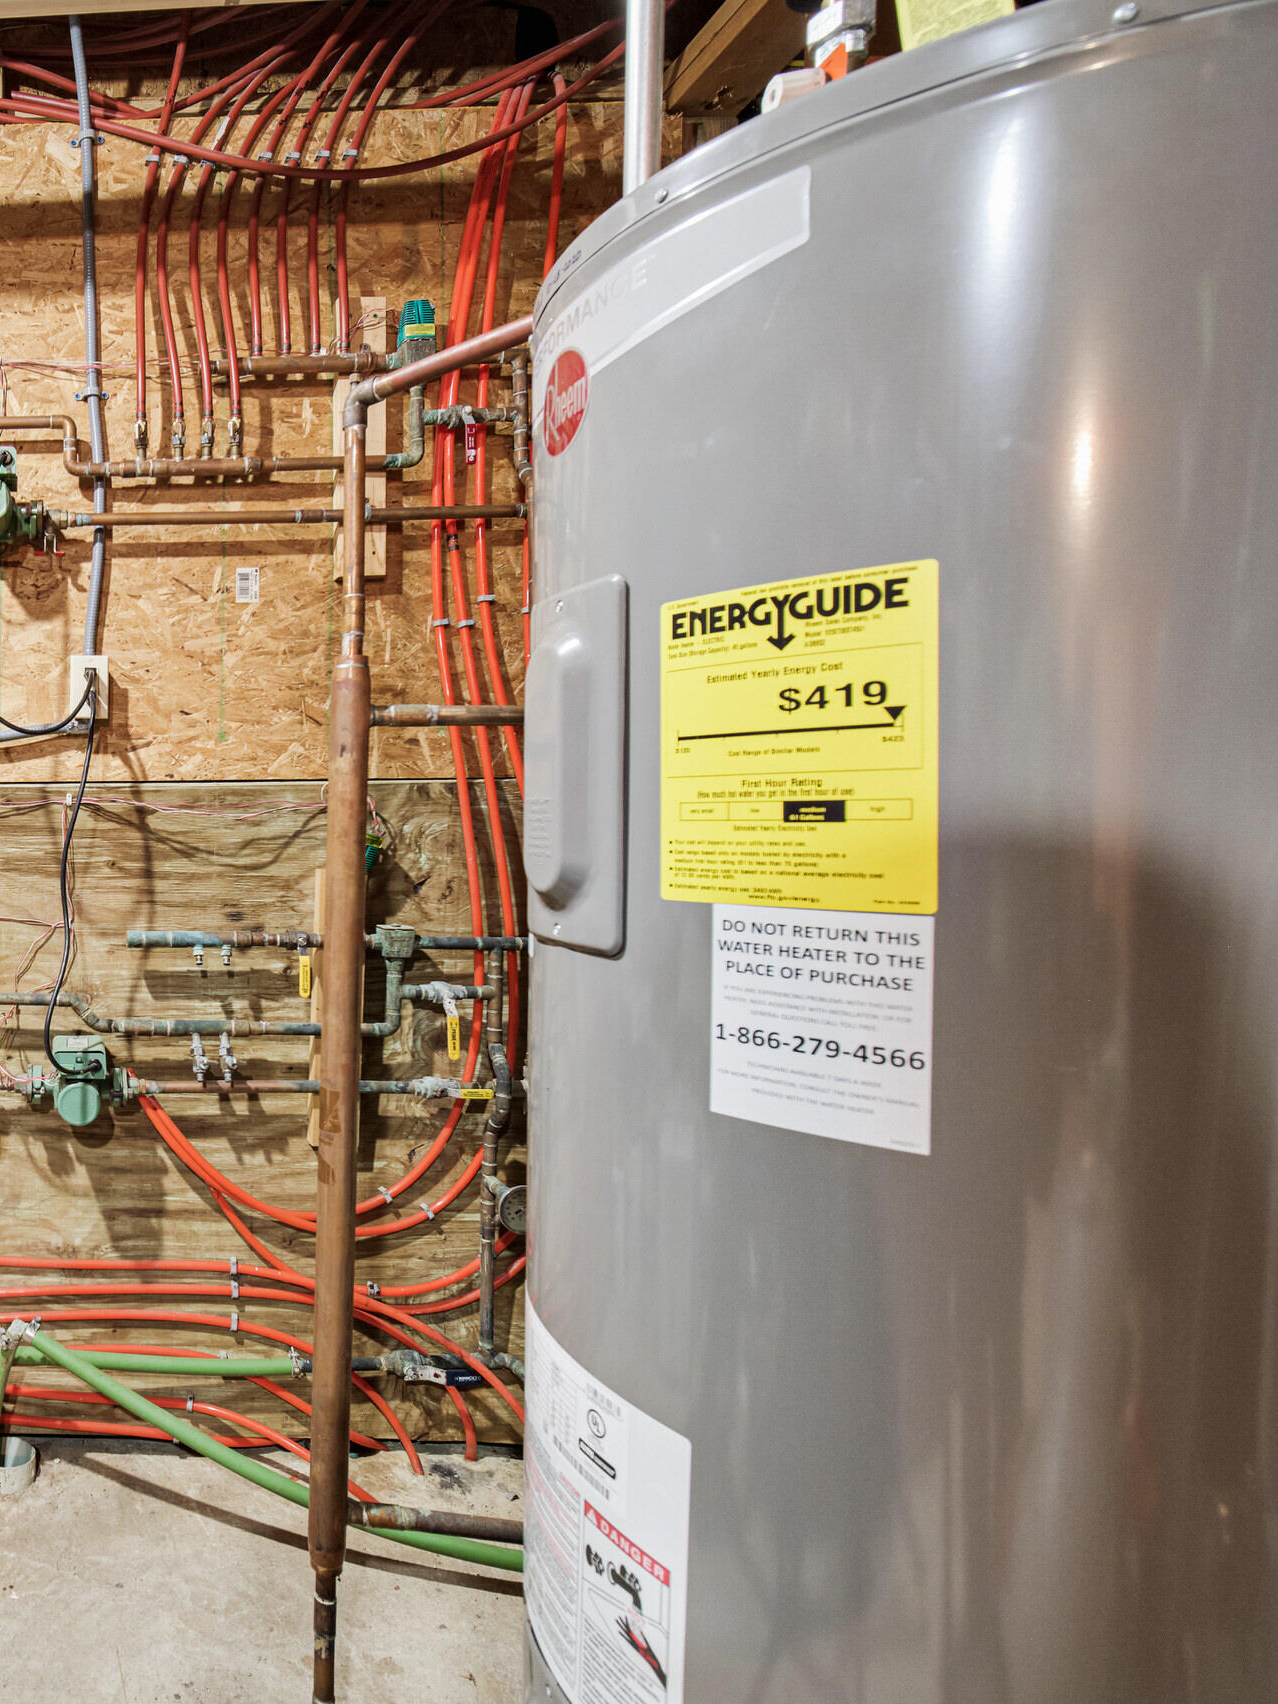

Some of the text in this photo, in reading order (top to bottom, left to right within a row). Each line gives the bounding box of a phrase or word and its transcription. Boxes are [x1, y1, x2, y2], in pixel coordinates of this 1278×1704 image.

[545, 362, 586, 444] Rheem
[707, 662, 843, 684] Estimated Yearly Energy Cost
[778, 680, 888, 715] $419
[742, 778, 823, 788] First Hour Rating
[723, 919, 921, 946] DO NOT RETURN THIS
[718, 940, 926, 970] WATER HEATER TO THE
[726, 960, 914, 991] PLACE OF PURCHASE
[715, 1023, 926, 1070] 1-866-279-4566
[599, 1518, 664, 1581] DANGER
